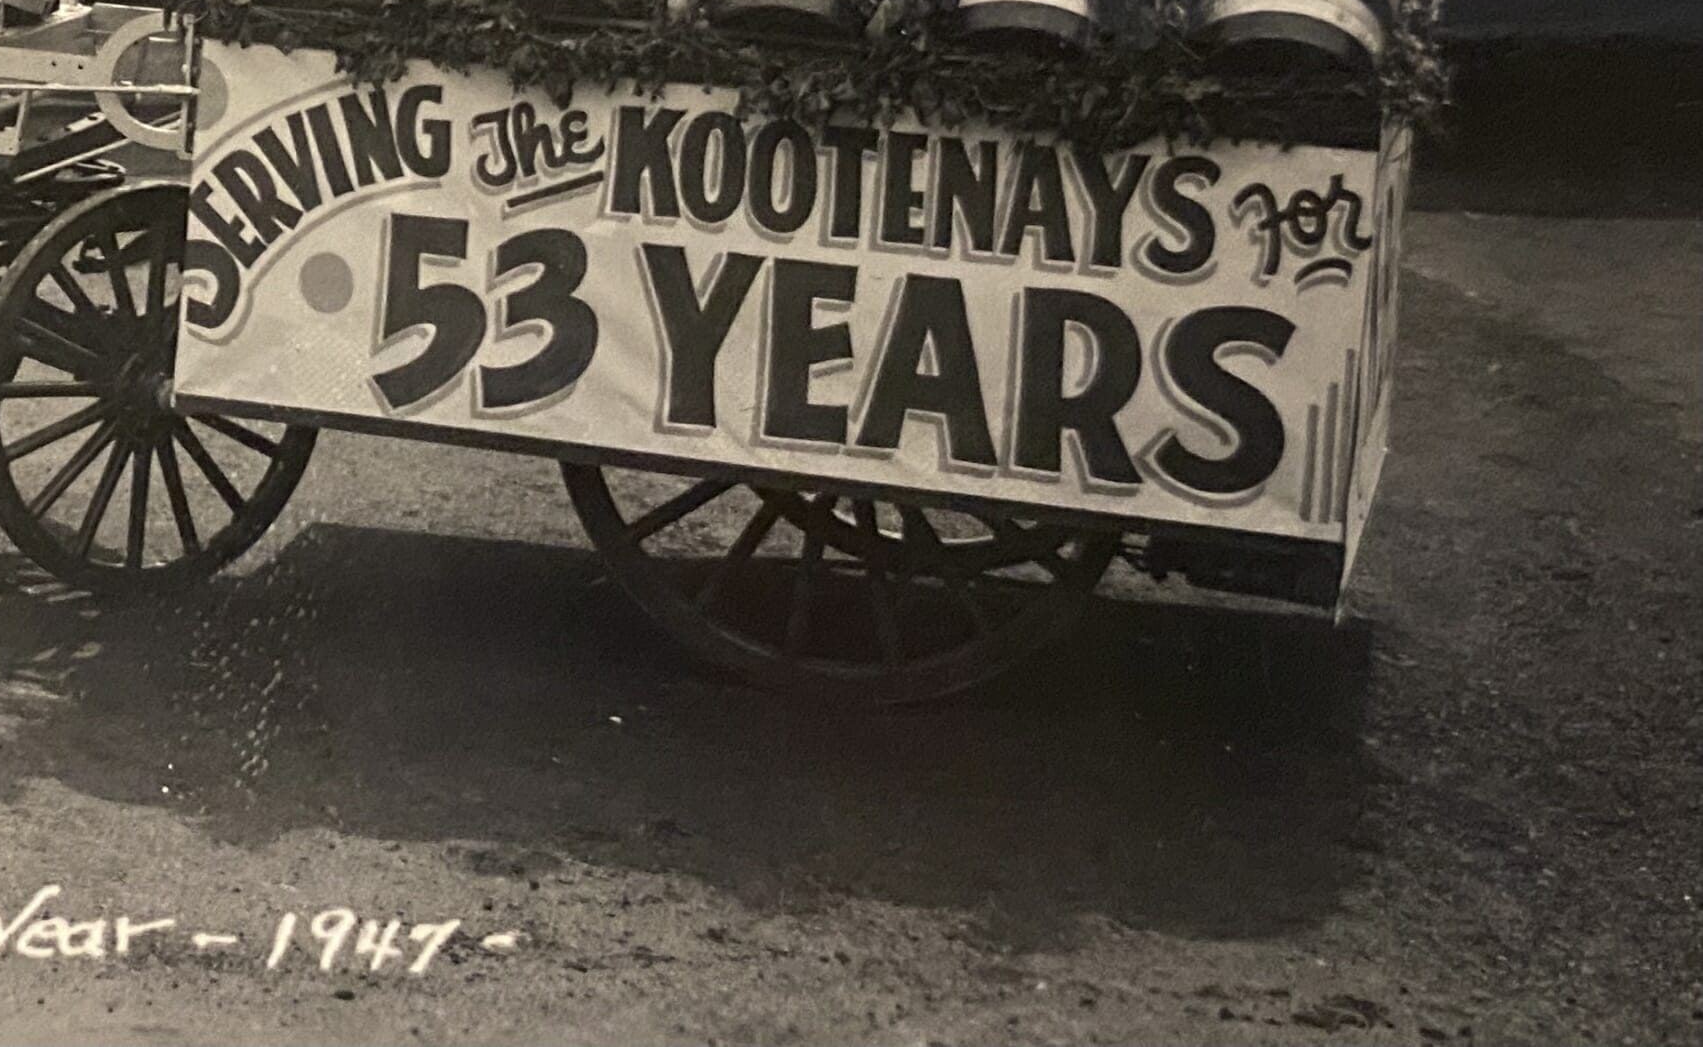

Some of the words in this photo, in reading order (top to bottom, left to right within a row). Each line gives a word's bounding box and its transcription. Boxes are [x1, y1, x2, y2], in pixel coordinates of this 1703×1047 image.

[470, 101, 606, 188] The
[608, 104, 1221, 274] KOOTENAYS
[1233, 174, 1373, 276] for
[368, 212, 601, 412] 53
[638, 240, 1298, 497] YEARS
